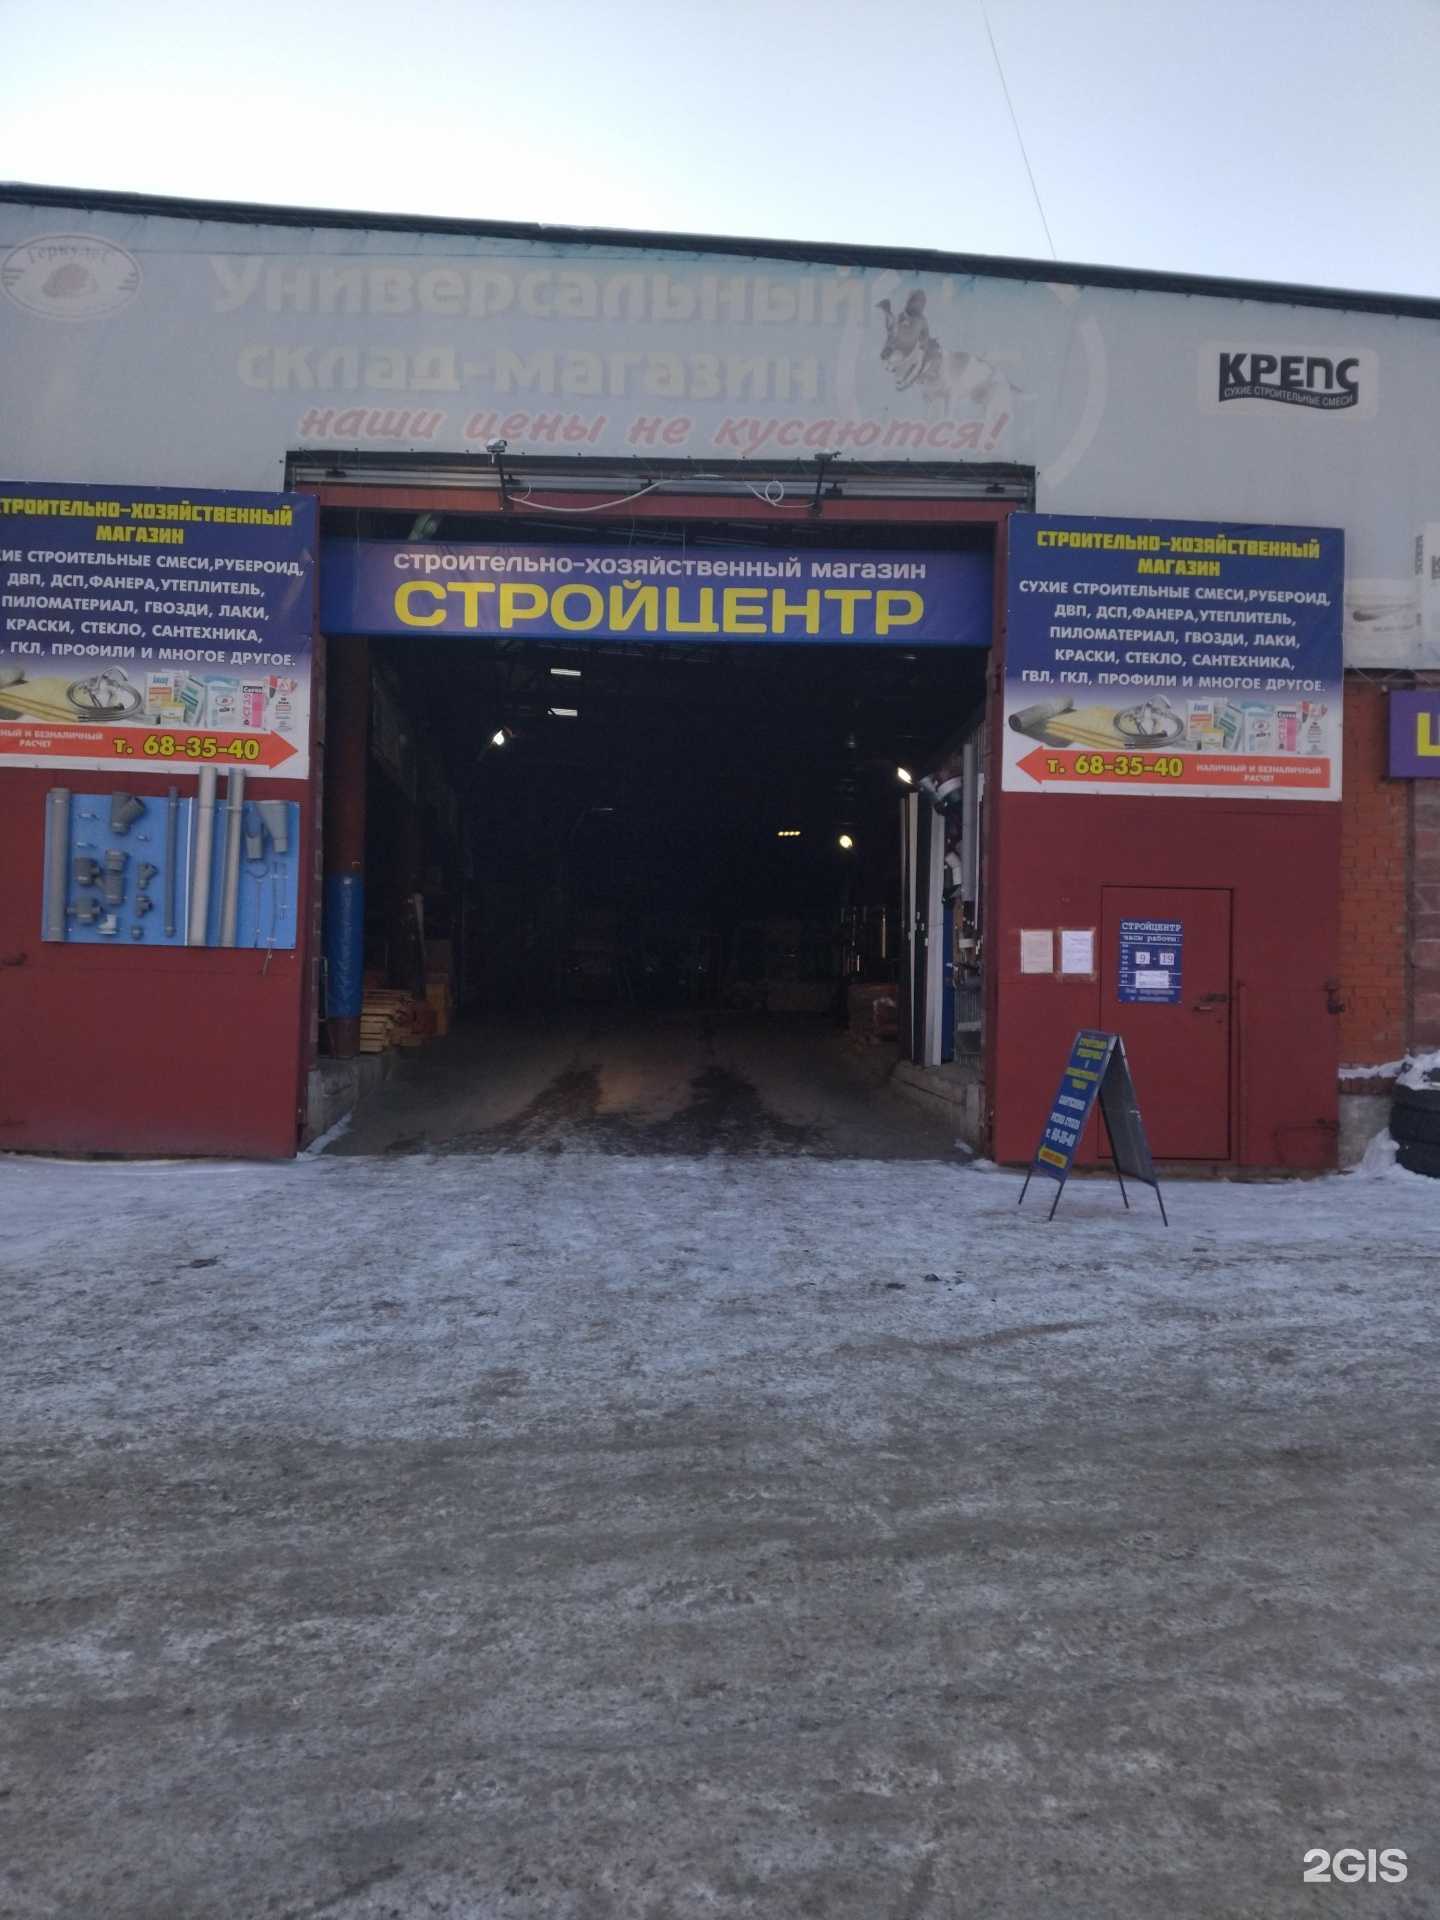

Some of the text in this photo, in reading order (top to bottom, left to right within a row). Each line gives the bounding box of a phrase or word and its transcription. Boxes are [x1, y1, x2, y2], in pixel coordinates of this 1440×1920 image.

[209, 255, 868, 323] Универсальный
[237, 343, 819, 400] склад-магазин
[1219, 353, 1359, 398] КРЕПС
[301, 407, 1010, 453] наши цены не кусаются!
[0, 497, 293, 527] ТРОИТЕЛЬНО-ХОЗЯЙСТВЕННЫЙ
[96, 525, 184, 545] МАГАЗИН
[1037, 530, 1320, 559] СТРОИТЕЛЬНО-ХОЗЯЙСТВЕННЫЙ
[27, 550, 152, 567] СТРОИТЕЛЬНЫЕ
[394, 553, 926, 580] строительно-хозяйственный магазин
[1137, 558, 1221, 577] МАГАЗИН
[7, 572, 46, 588] ДВП,
[1019, 580, 1069, 594] СУХИЕ
[1073, 582, 1190, 599] СТРОИТЕЛЬНЫЕ
[1, 595, 270, 621] ПИЛОМАТЕРИАЛ, ГВОЗДИ, ЛАКИ,
[394, 579, 925, 635] СТРОЙЦЕНТР
[1054, 604, 1092, 619] ДВП,
[6, 618, 263, 643] КРАСКИ, СТЕКЛО, САНТЕХНИКА,
[1050, 626, 1301, 649] ПИЛОМАТЕРИАЛ, ГВОЗДИ, ЛАКИ,
[10, 641, 296, 666] ГКЛ, ПРОФИЛИ И МНОГОЕ ДРУГОЕ.
[1055, 649, 1296, 671] КРАСКИ, СТЕКЛО, САНТЕХНИКА,
[1022, 670, 1326, 692] ГВЛ, ГКЛ, ПРОФИЛИ И МНОГОЕ ДРУГОЕ.
[143, 735, 260, 760] 68-35-40
[1074, 754, 1184, 777] 68-35-40
[1121, 921, 1182, 933] СТРОЙЦЕНТР
